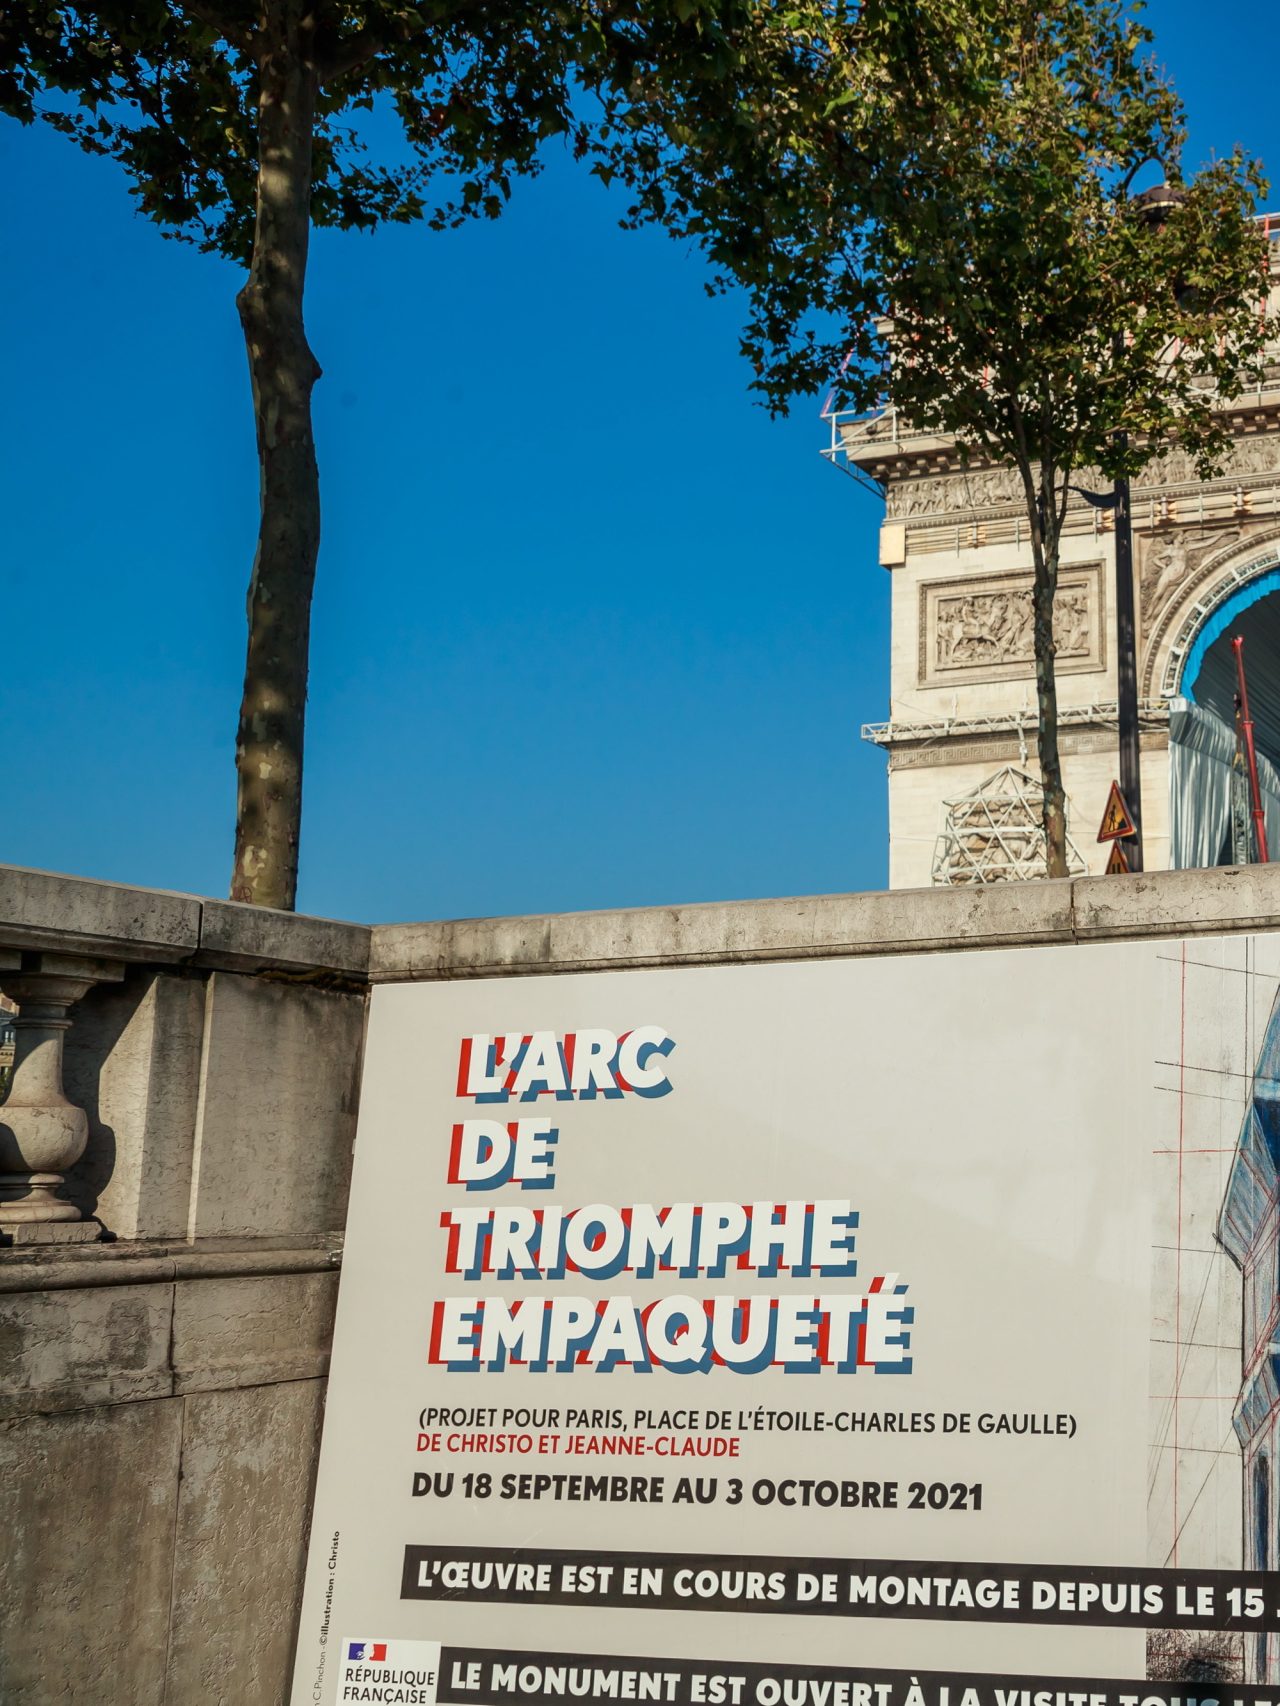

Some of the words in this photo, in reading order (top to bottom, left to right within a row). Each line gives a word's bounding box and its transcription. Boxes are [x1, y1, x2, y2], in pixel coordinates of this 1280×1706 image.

[456, 1025, 677, 1104] L'ARC
[447, 1117, 559, 1191] DE
[440, 1199, 859, 1281] TRIOMPHE
[428, 1272, 914, 1375] EMPAQUETÉ
[419, 1408, 497, 1430] (PROJET
[502, 1409, 560, 1428] POUR
[565, 1409, 627, 1432] PARIS,
[633, 1410, 699, 1430] PLACE
[705, 1411, 732, 1431] DE
[738, 1406, 936, 1433] L'ÉTOILE-CHARLES
[942, 1413, 971, 1434] DE
[977, 1414, 1077, 1438] GAULLE)
[416, 1433, 442, 1452] DE
[446, 1434, 533, 1454] CHRISTO
[538, 1435, 561, 1454] ET
[565, 1435, 740, 1457] JEANNE-CLAUDE
[411, 1472, 455, 1498] DU
[461, 1473, 492, 1499] 18
[499, 1474, 665, 1503] SEPTEMBRE
[671, 1477, 718, 1505] AU
[725, 1478, 743, 1505] 3
[752, 1479, 899, 1509] OCTOBRE
[907, 1481, 983, 1511] 2021
[328, 1531, 340, 1570] Christo
[561, 1565, 614, 1594] EST
[622, 1567, 664, 1596] EN
[673, 1569, 786, 1601] COURS
[796, 1573, 838, 1603] DE
[849, 1575, 1020, 1609] MONTAGE
[1032, 1580, 1164, 1614] DEPUIS
[1176, 1586, 1215, 1616] LE
[1226, 1588, 1265, 1618] 15
[343, 1687, 427, 1705] FRANÇAISE
[345, 1665, 435, 1689] RÉPUBLIQUE
[451, 1661, 482, 1690] LE
[490, 1663, 682, 1702] MONUMENT
[690, 1674, 747, 1704] EST
[755, 1677, 893, 1706] OUVERT
[904, 1676, 926, 1706] À
